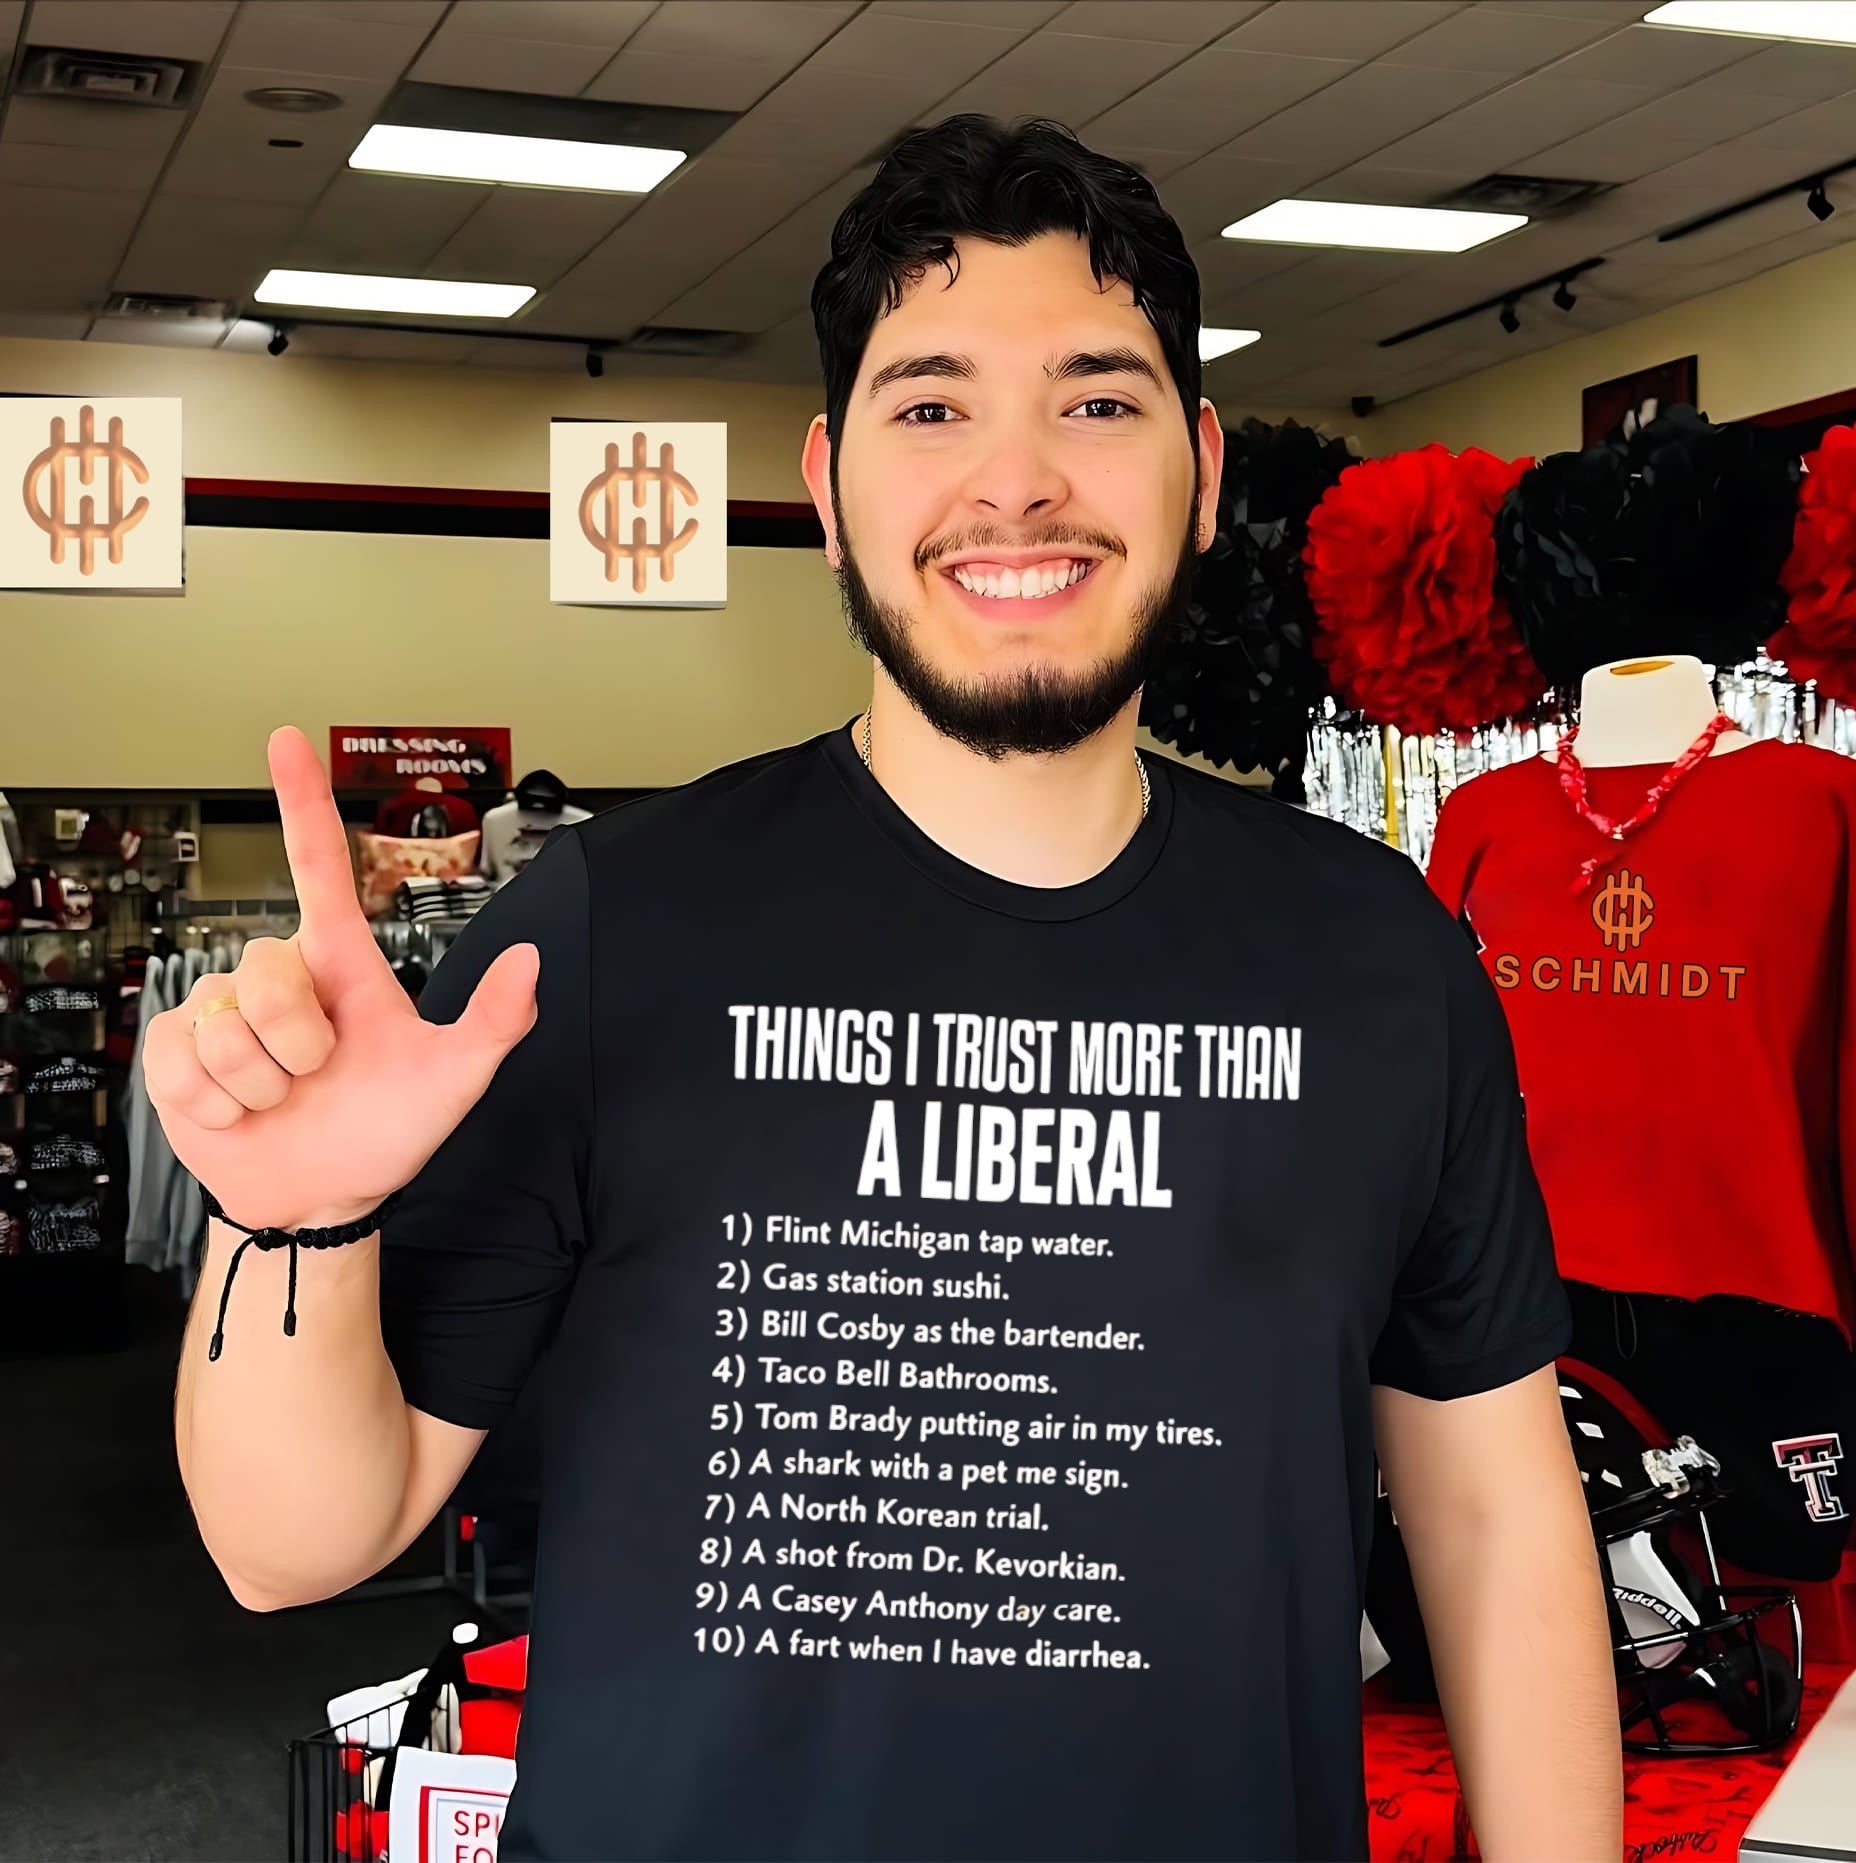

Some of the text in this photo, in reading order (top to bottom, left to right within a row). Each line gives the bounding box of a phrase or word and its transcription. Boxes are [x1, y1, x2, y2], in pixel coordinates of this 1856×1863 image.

[395, 757, 488, 775] ROOMS
[1494, 953, 1747, 1000] SCHMIDT
[727, 1004, 1302, 1101] THINGS I TRUST MORE THAN
[856, 1099, 1173, 1209] A LIBERAL
[721, 1211, 1114, 1263] 1) Flint Michigan tap water.
[716, 1258, 1010, 1301] 2) Gas station sushi.
[714, 1306, 1145, 1351] 3) Bill Cosby as the bartender.
[711, 1353, 1058, 1395] 4) Taco Bell Bathrooms.
[710, 1400, 1222, 1452] 5) Tom Brady putting air in my tires.
[707, 1447, 1129, 1496] 6) A shark with a pet me sign.
[704, 1491, 1049, 1532] 7) A North Korean trial.
[699, 1535, 1126, 1582] 8) A shot from Dr. Kevorkian.
[695, 1580, 1121, 1629] 9) A Casey Anthony day care.
[693, 1624, 1151, 1670] 10) A fart when I have diarrhea.
